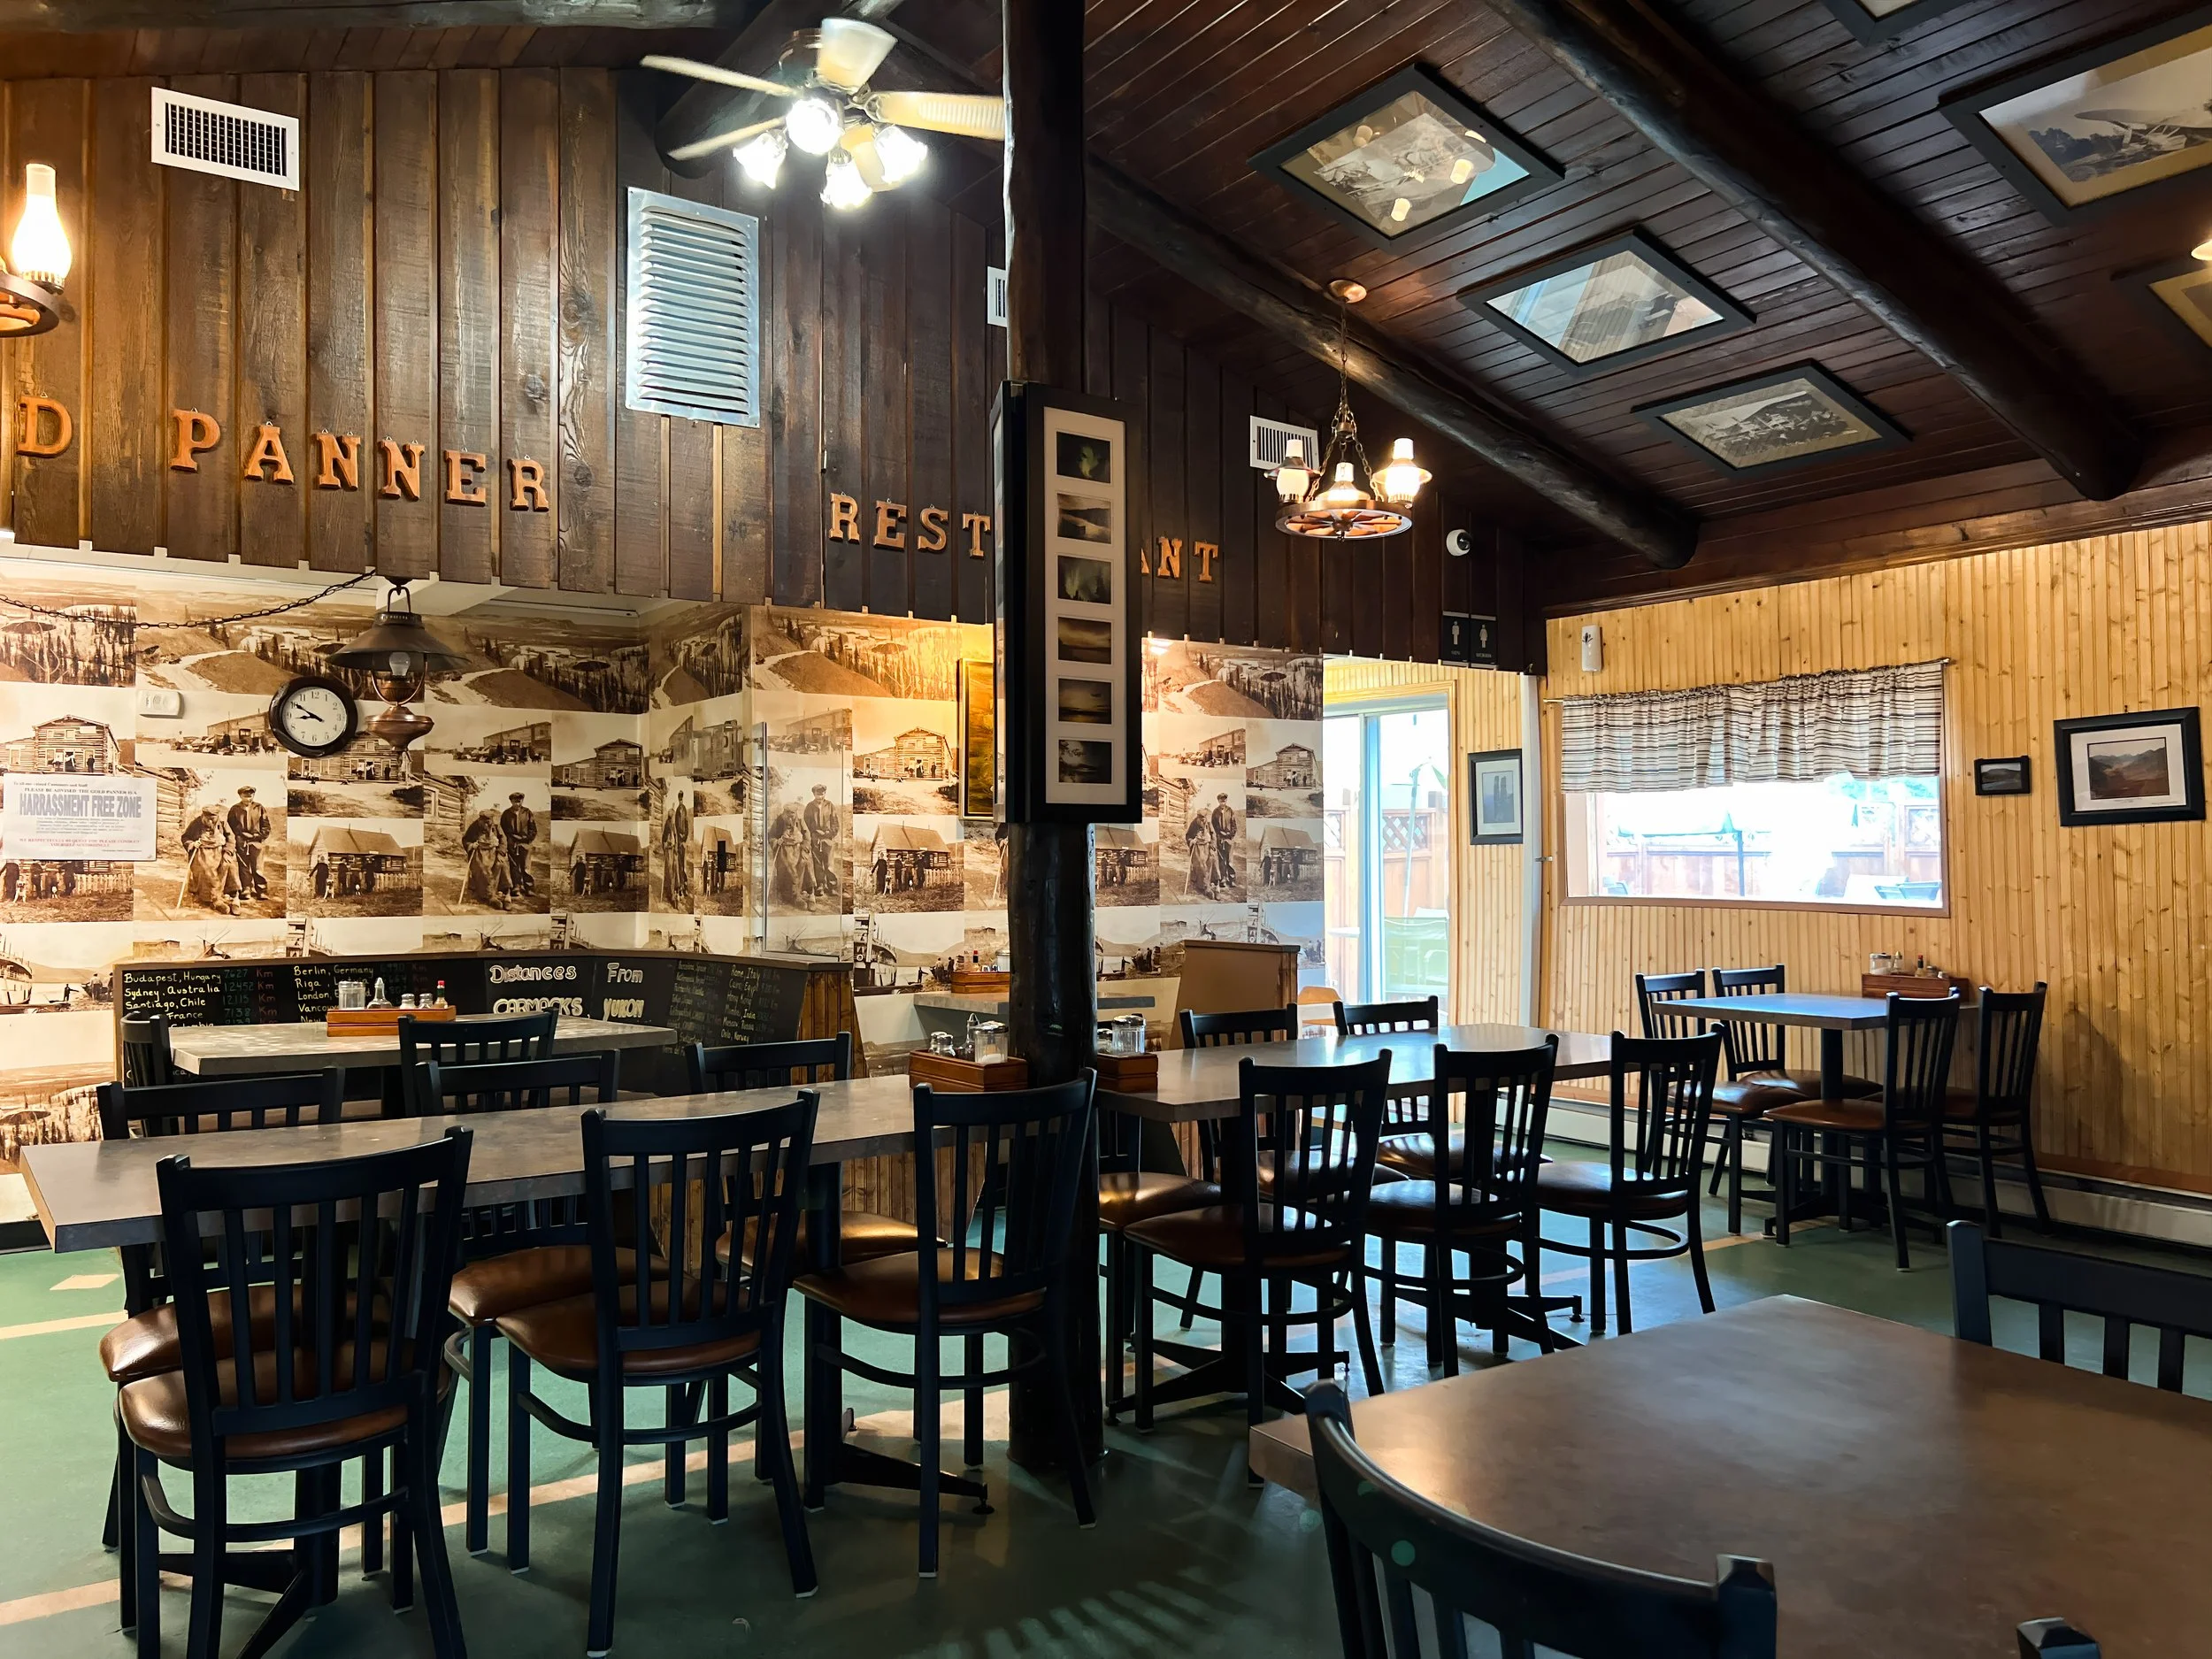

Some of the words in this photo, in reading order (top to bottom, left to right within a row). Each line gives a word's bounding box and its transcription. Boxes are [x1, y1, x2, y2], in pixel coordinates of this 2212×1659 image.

[16, 395, 73, 458] D
[170, 407, 550, 512] PANNER
[828, 492, 1219, 584] RESTNT
[311, 691, 319, 700] 12
[19, 793, 89, 817] HARRASSMENT
[92, 795, 115, 818] FREE
[116, 796, 142, 818] ZONE
[124, 972, 184, 985] Budapest,
[183, 972, 222, 984] Hungary
[256, 968, 273, 978] Km
[334, 964, 374, 978] Germany
[489, 964, 577, 984] Distances
[607, 962, 643, 983] From
[257, 981, 275, 991] Km
[180, 997, 206, 1007] Chile
[166, 1011, 204, 1020] France
[259, 1007, 278, 1017] Km
